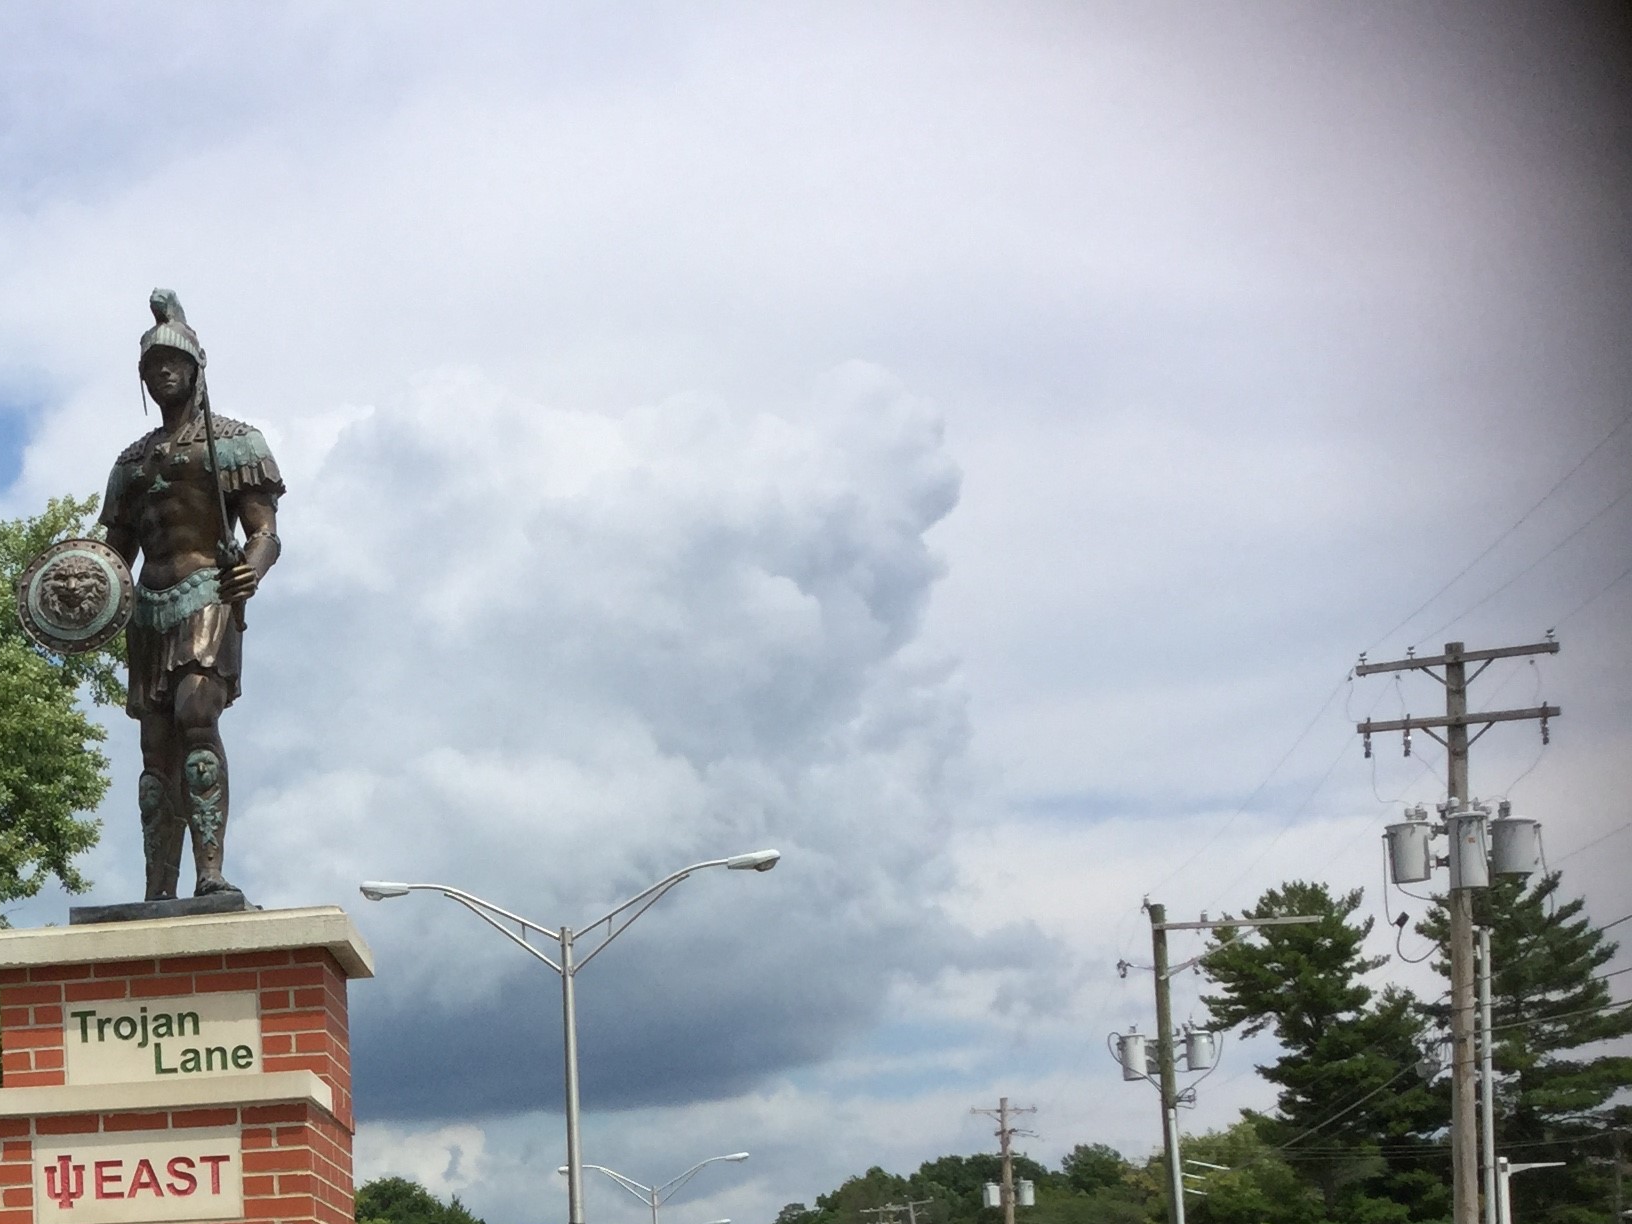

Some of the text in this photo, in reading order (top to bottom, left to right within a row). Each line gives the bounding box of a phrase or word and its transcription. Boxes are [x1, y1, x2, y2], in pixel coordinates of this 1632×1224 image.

[71, 1006, 200, 1048] Trojan
[154, 1043, 254, 1075] Lane
[95, 1155, 230, 1200] EAST
